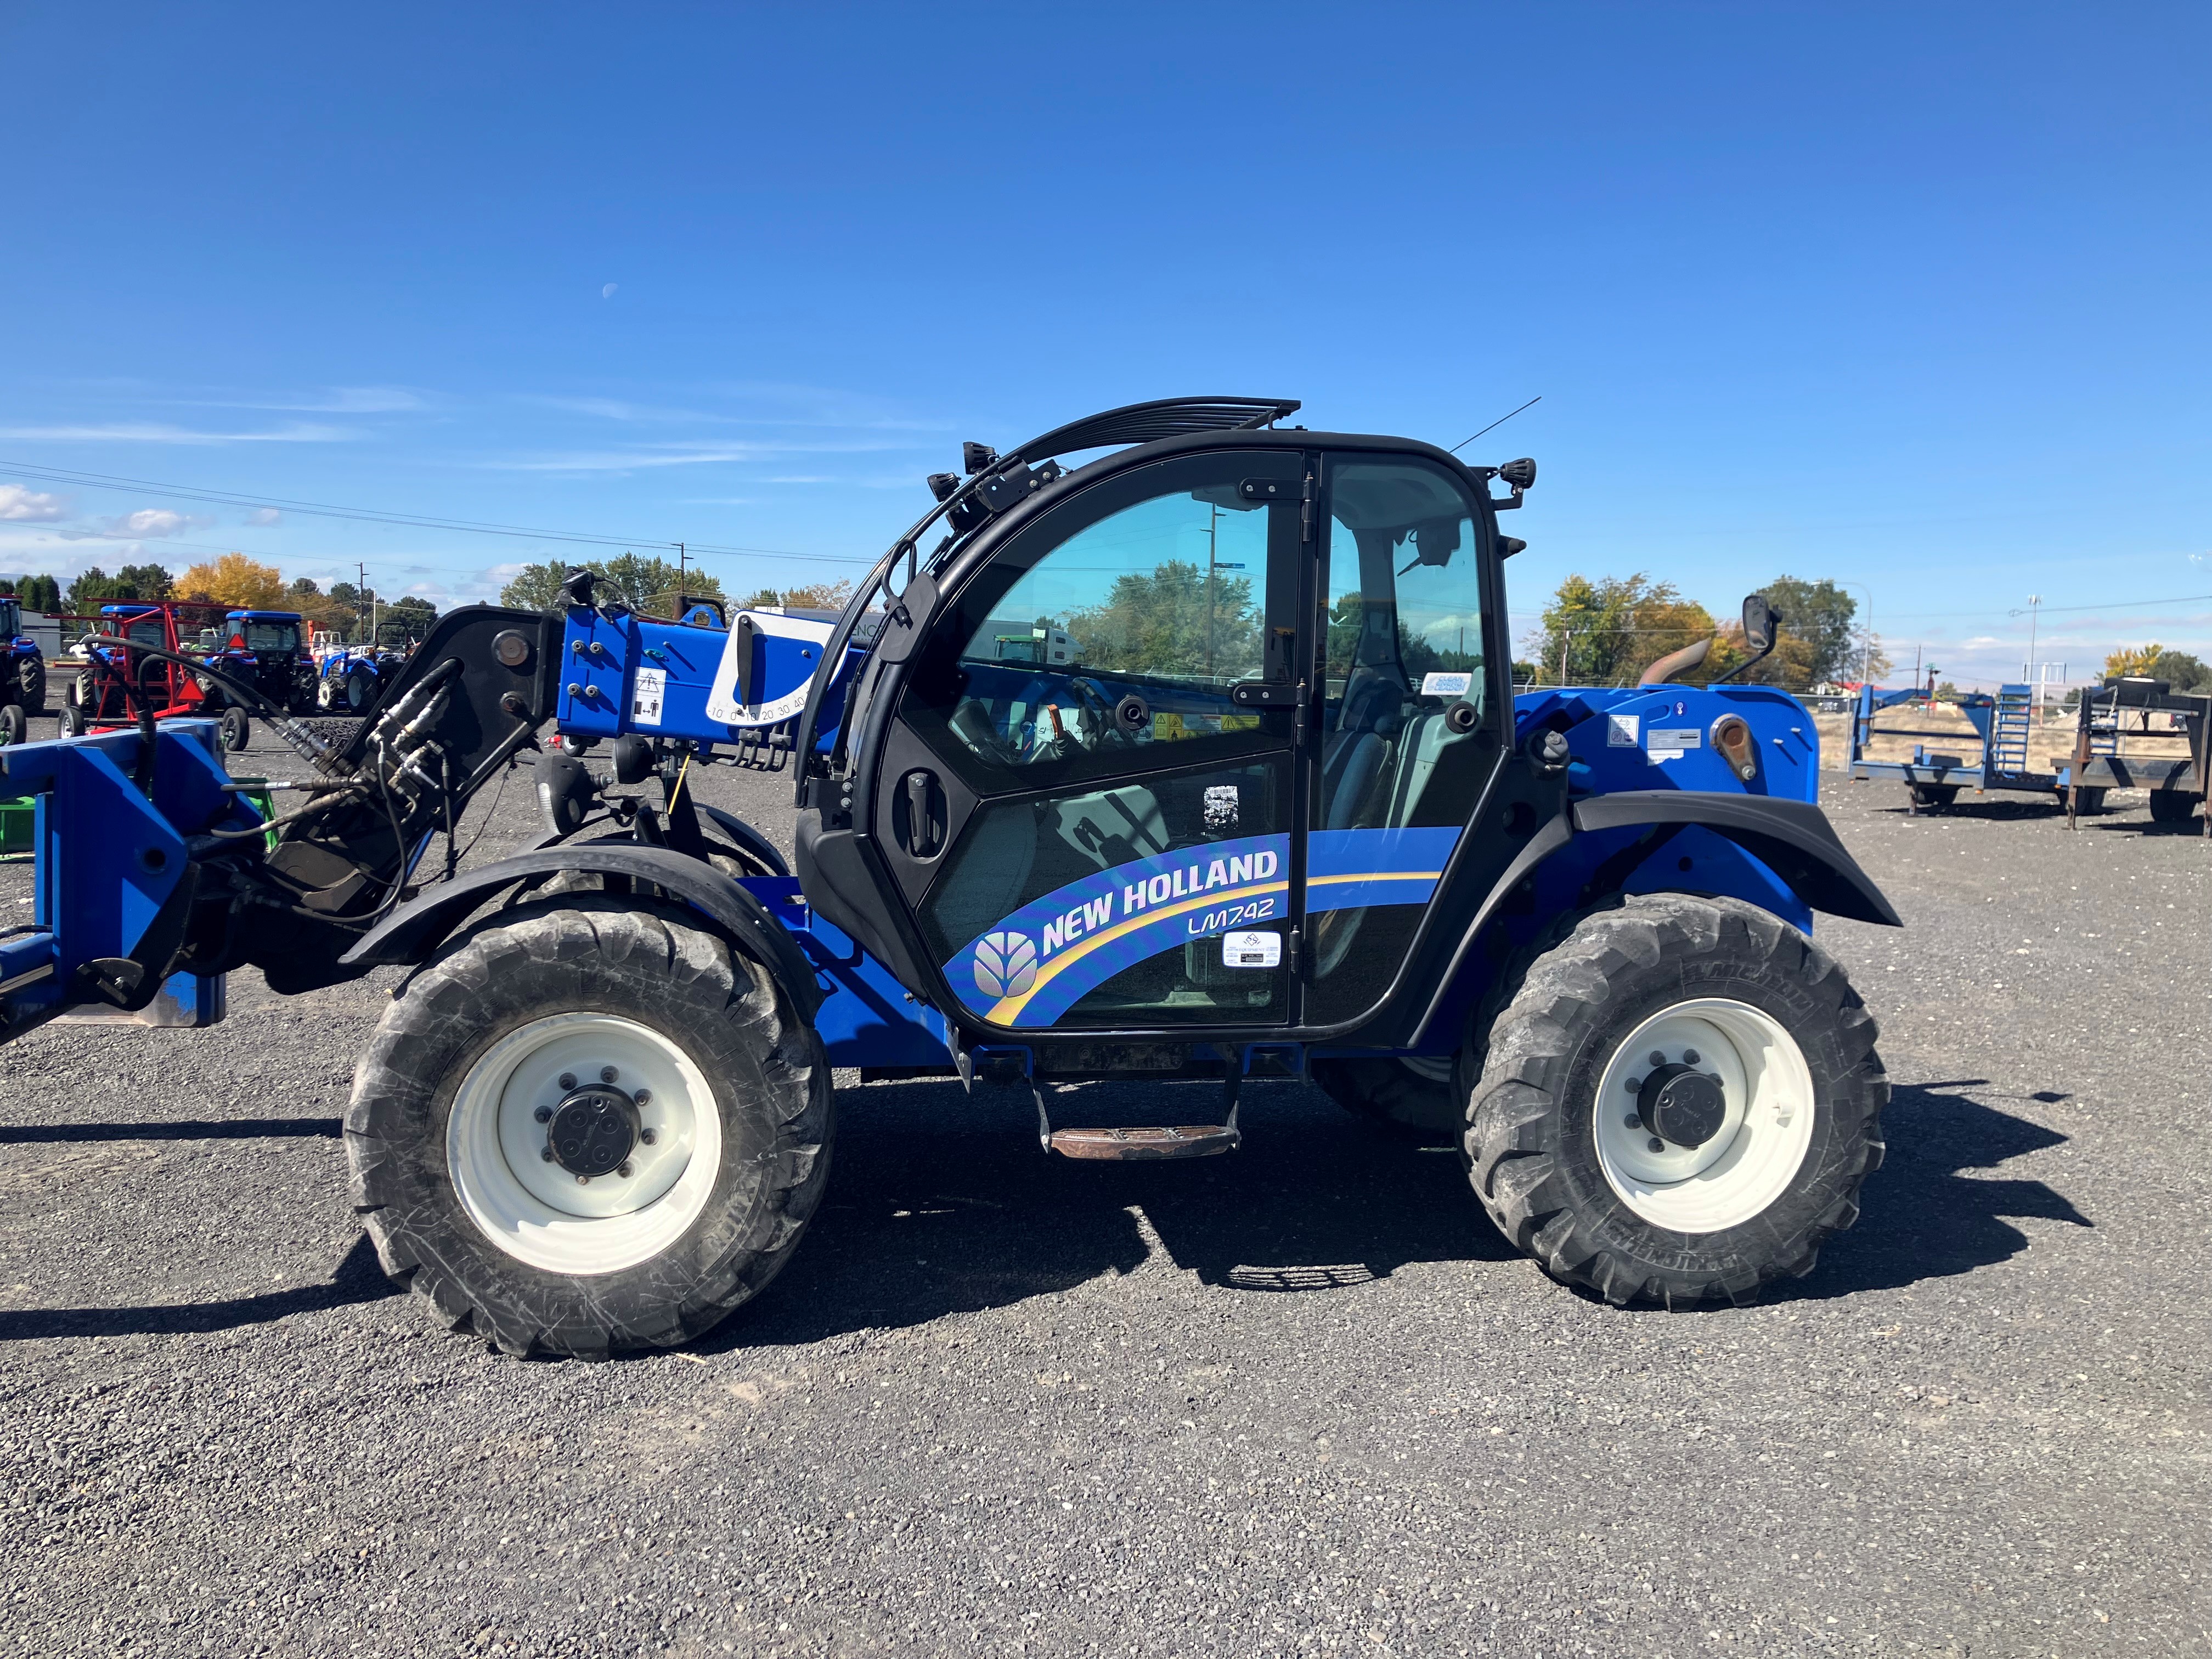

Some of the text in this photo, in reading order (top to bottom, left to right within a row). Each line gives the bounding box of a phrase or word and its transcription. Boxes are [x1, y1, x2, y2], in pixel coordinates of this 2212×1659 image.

[1043, 850, 1278, 957] NEW HOLLAND
[1708, 962, 1814, 1010] MICHELIN
